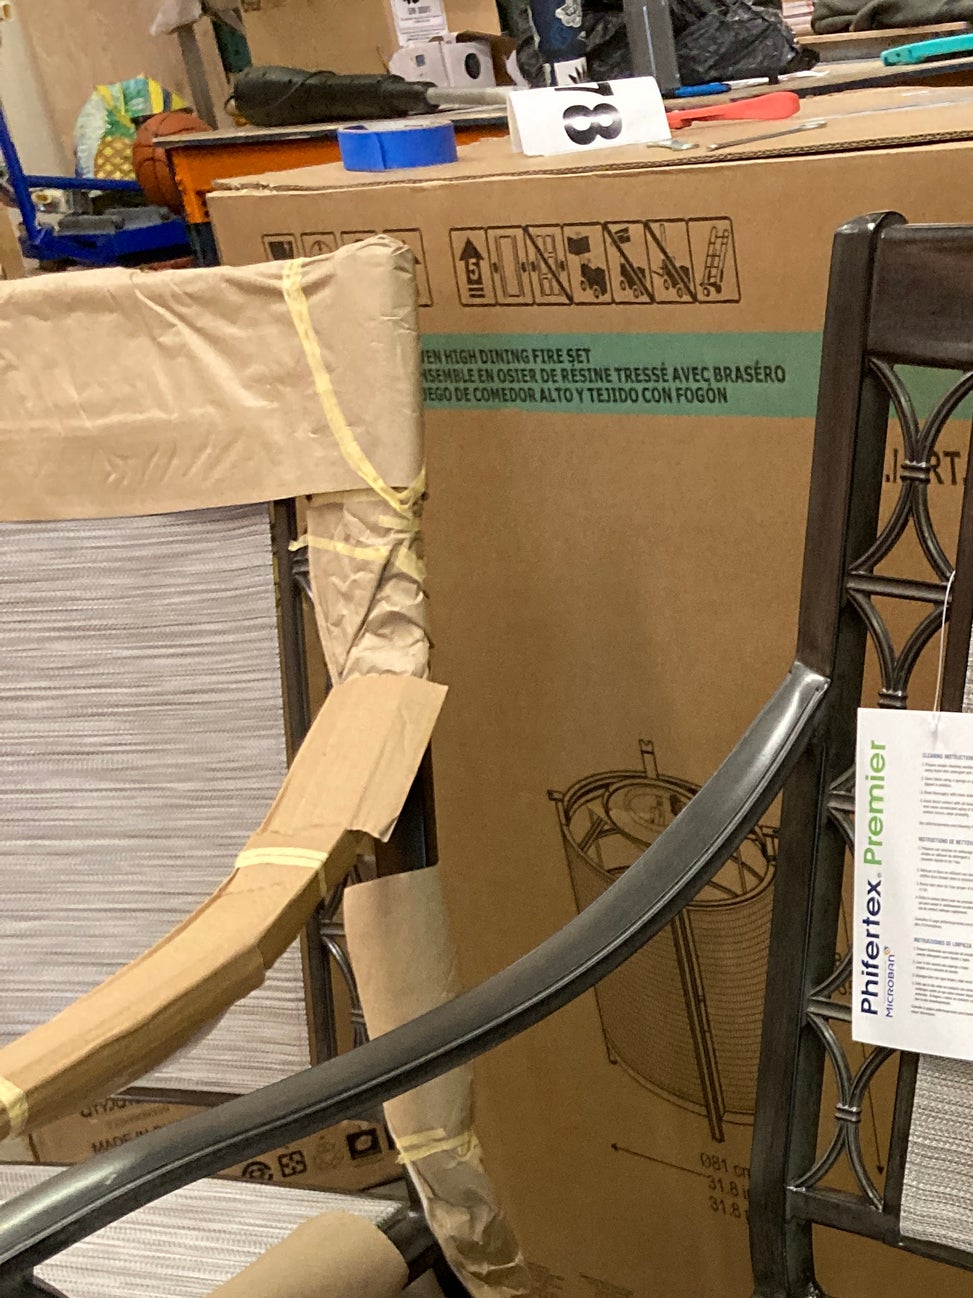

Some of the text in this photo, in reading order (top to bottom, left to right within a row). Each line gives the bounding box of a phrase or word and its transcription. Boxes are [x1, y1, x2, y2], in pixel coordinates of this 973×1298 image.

[445, 349, 476, 365] HIGH
[479, 348, 530, 365] DINING
[532, 348, 563, 365] FIRE
[567, 348, 592, 365] SET
[478, 369, 495, 384] EN
[497, 368, 538, 384] OSIER
[541, 368, 559, 384] DE
[615, 362, 669, 384] TRESSÉ
[672, 365, 711, 384] AVEC
[713, 360, 786, 384] BRASÉRO
[454, 387, 470, 403] DE
[473, 387, 537, 403] COMEDOR
[539, 387, 574, 403] ALTO
[574, 387, 584, 403] Y
[586, 387, 639, 404] TEJIDO
[641, 387, 672, 404] CON
[675, 381, 729, 404] FOGÓN
[863, 739, 886, 866] Premier
[861, 879, 881, 1016] Phifertex
